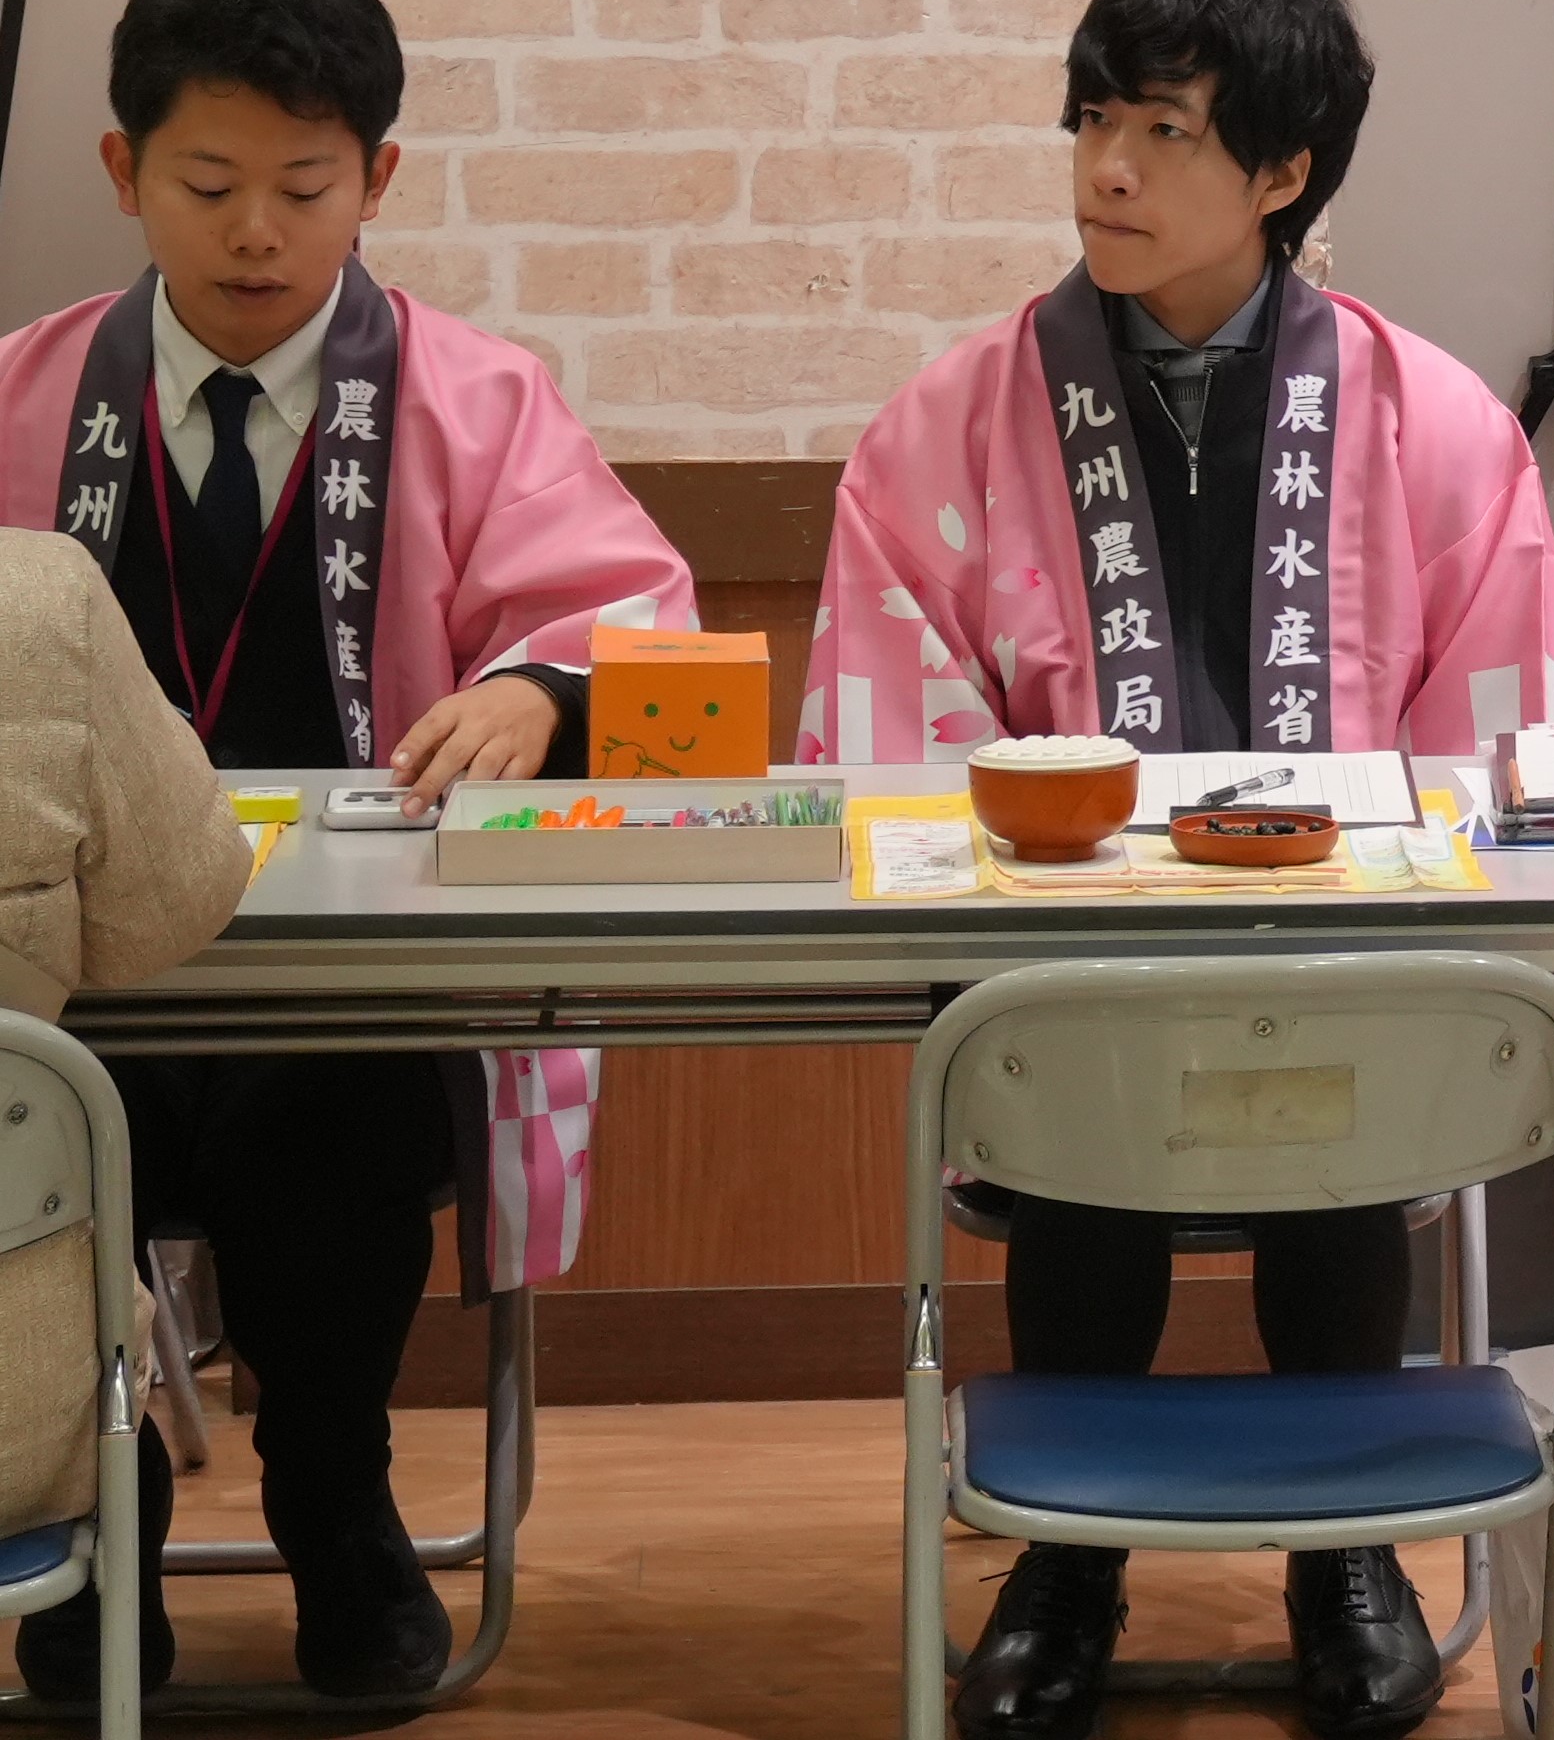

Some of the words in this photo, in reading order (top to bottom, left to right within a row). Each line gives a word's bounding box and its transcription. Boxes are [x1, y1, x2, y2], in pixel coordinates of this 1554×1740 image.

[67, 401, 128, 542] 九州
[319, 378, 382, 763] 農林水産省
[1058, 381, 1164, 738] 九州農政局
[1261, 373, 1330, 746] 農林水産省
